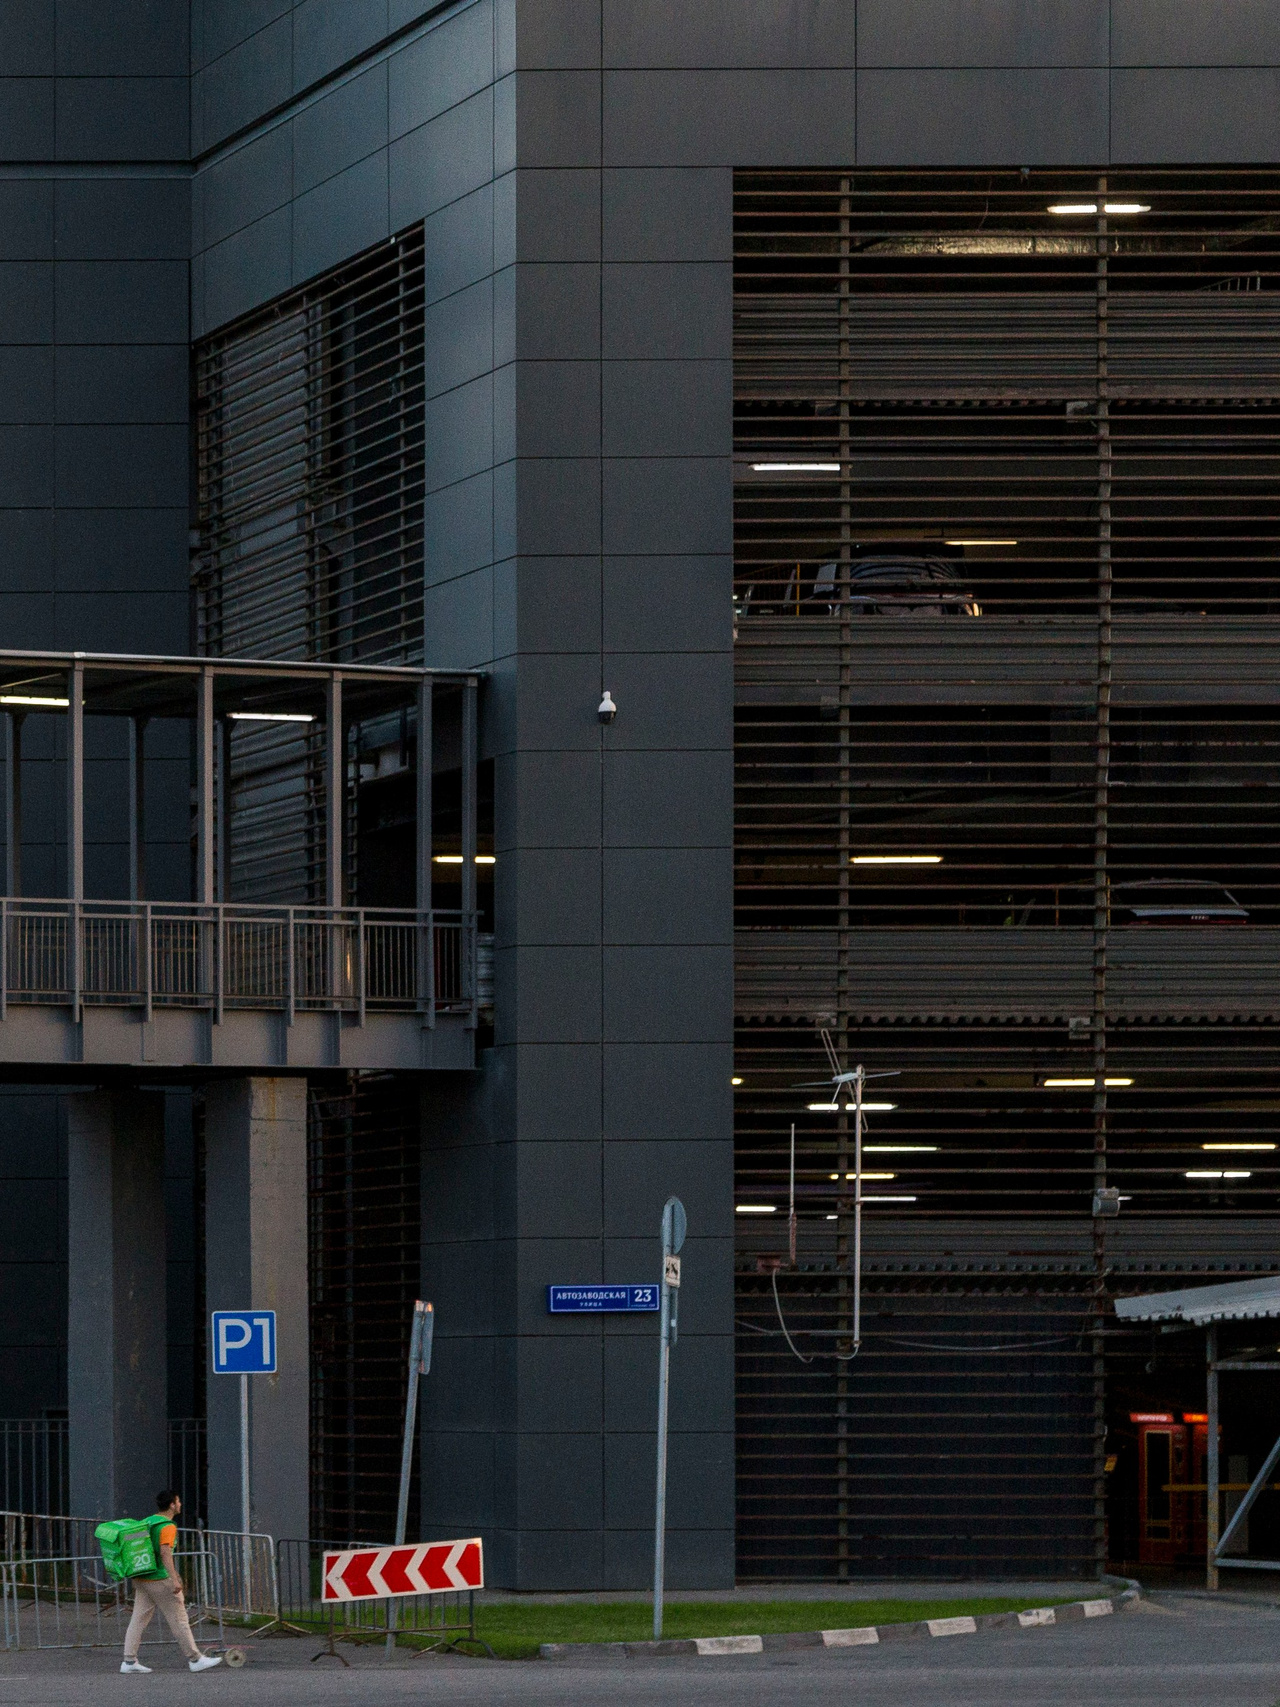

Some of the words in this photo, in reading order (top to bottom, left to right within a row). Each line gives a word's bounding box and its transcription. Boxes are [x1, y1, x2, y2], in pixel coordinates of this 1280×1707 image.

[556, 1291, 626, 1300] АВТОЗАВОДСКАЯ
[634, 1289, 652, 1302] 23
[219, 1318, 270, 1366] P1
[134, 1553, 151, 1567] 20
